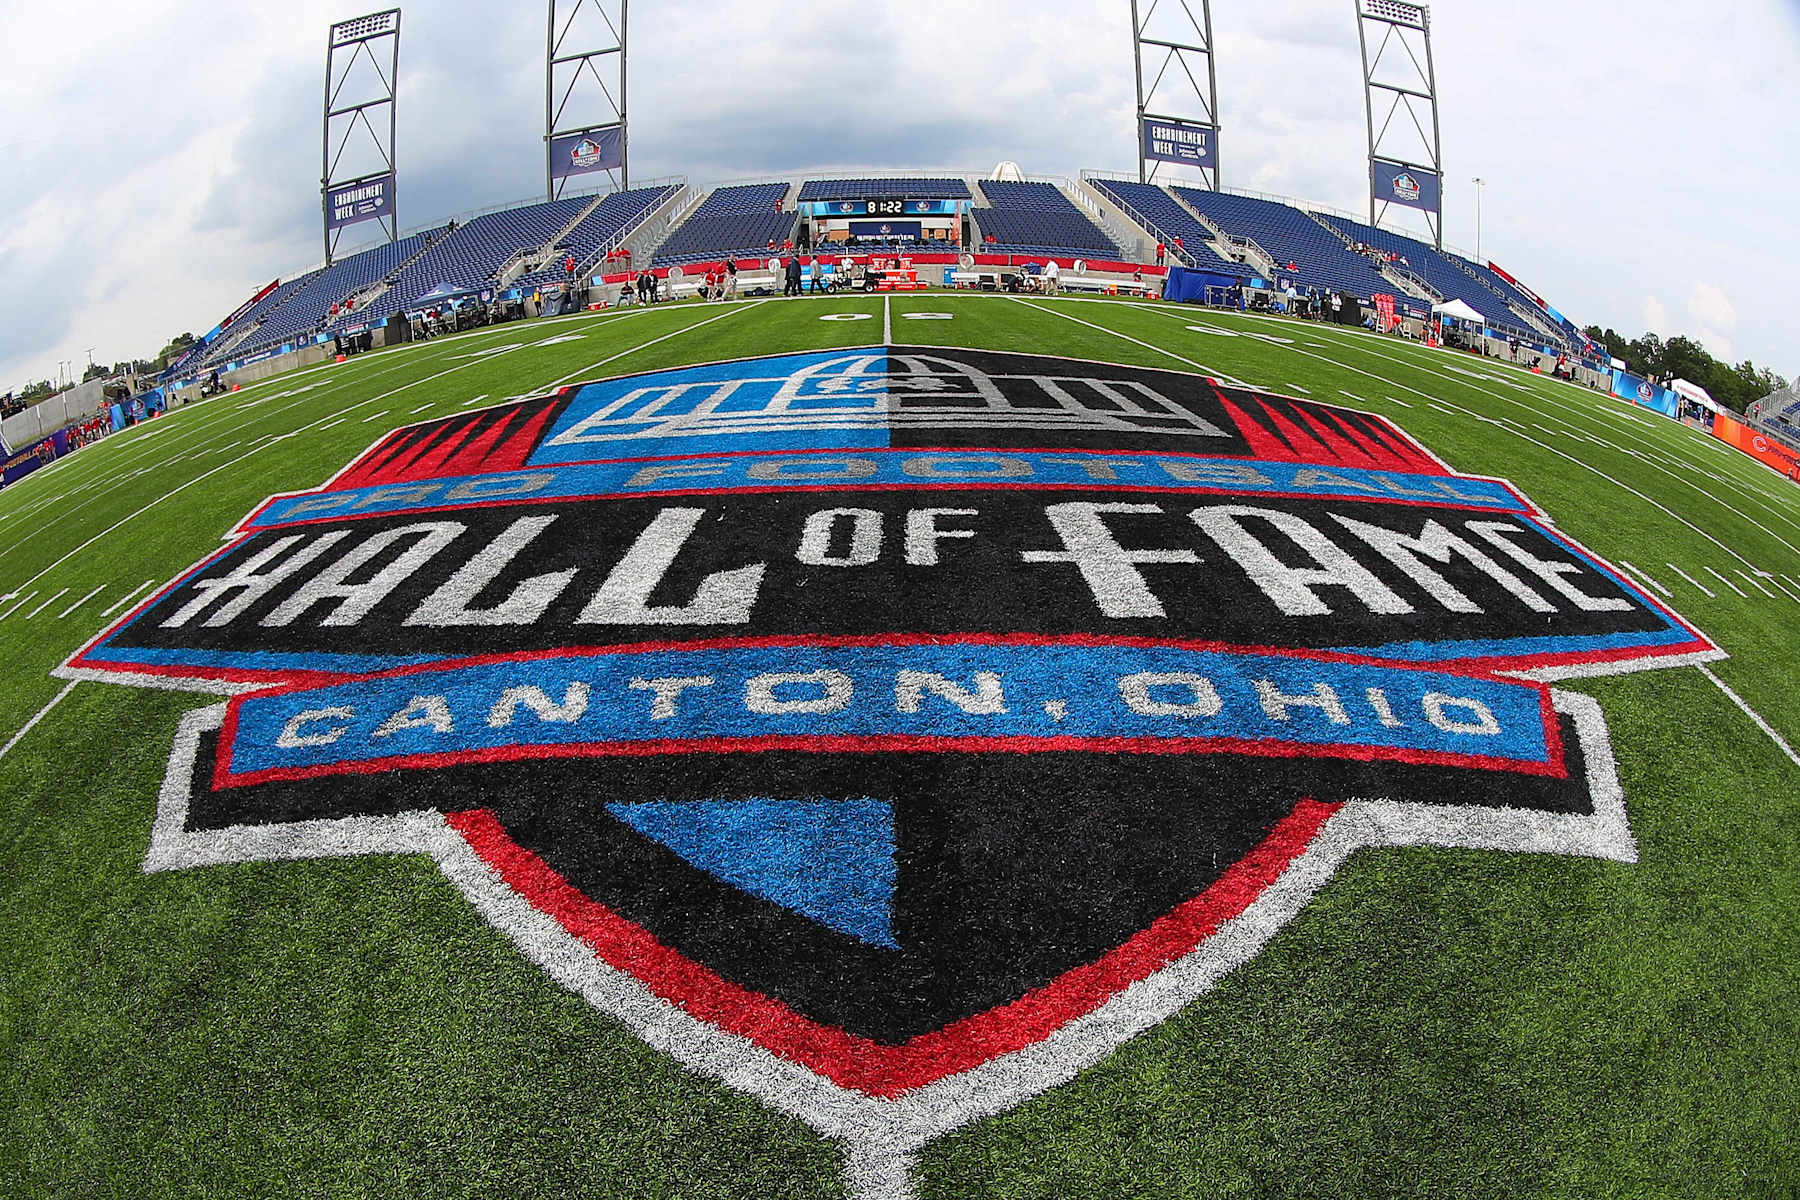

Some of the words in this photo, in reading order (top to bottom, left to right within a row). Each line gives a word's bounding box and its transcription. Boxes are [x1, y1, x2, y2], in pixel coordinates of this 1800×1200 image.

[1152, 140, 1174, 155] WEEK
[335, 205, 354, 220] WEEK
[868, 201, 876, 213] 8
[880, 201, 902, 213] 1:22
[279, 473, 556, 519] PRO
[623, 458, 1504, 502] FOOTBALL
[158, 507, 767, 629] HALL
[796, 507, 979, 567] OF
[1019, 501, 1636, 619] FAME
[1118, 669, 1501, 736] OHIO
